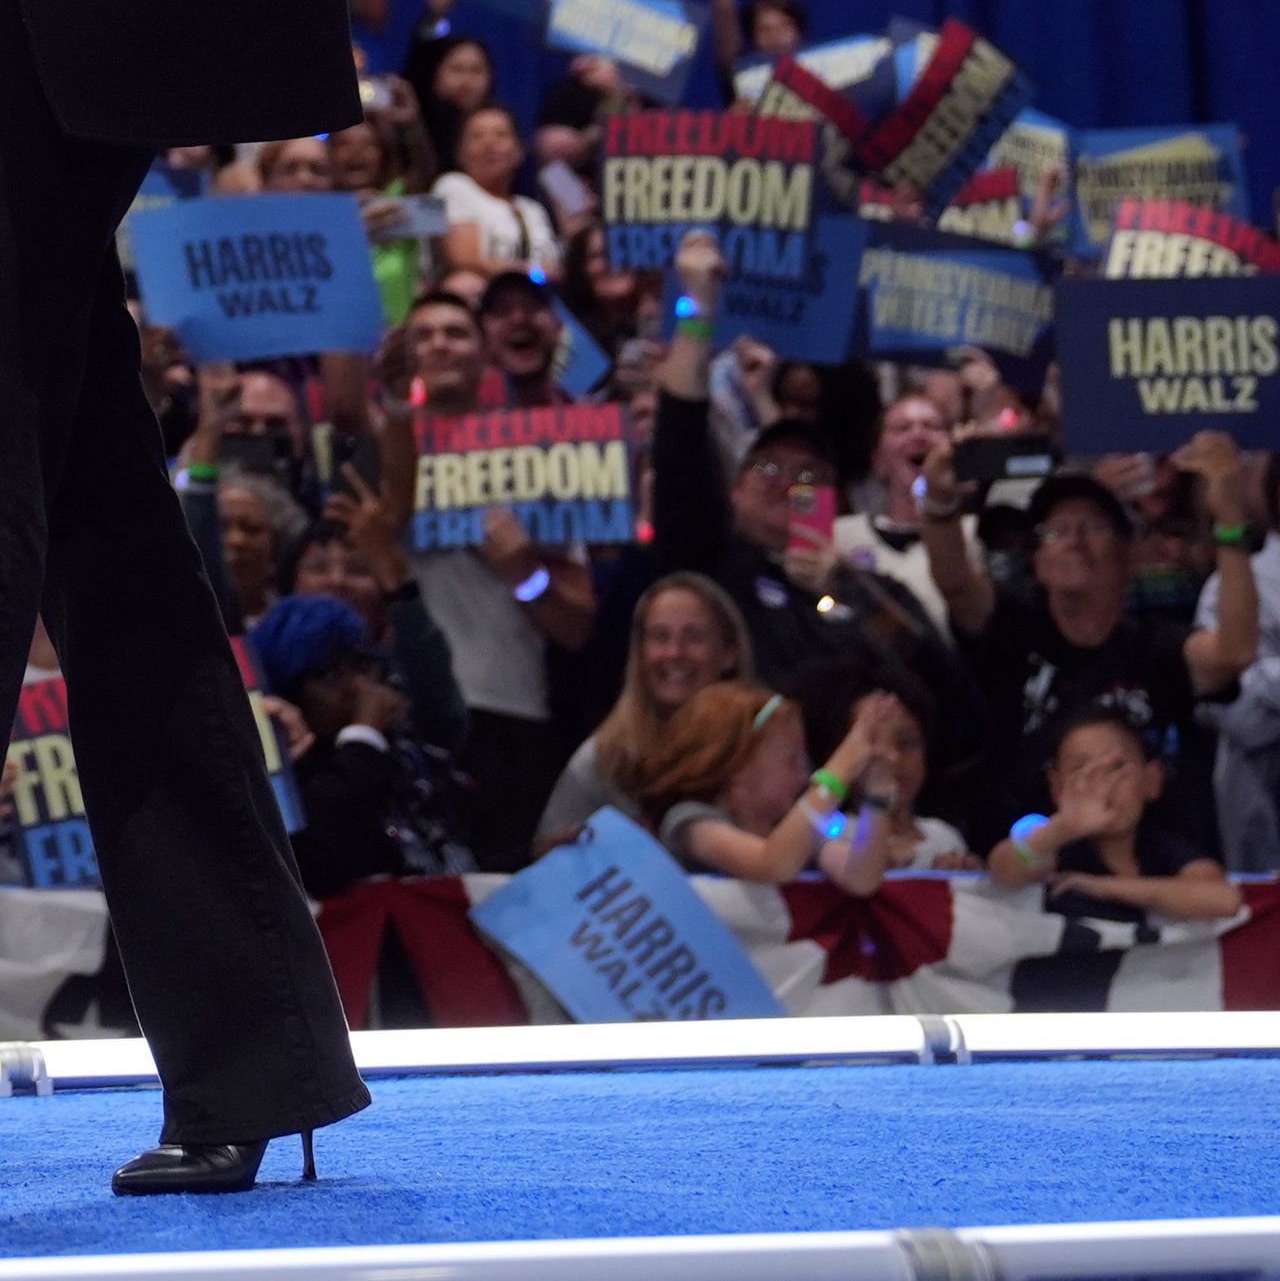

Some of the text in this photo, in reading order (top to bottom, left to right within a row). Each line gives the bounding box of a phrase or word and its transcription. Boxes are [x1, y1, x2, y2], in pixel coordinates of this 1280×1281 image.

[604, 155, 814, 232] FREEDOM
[183, 230, 334, 289] HARRIS
[217, 284, 318, 320] WALZ
[1108, 315, 1280, 379] HARRIS
[1138, 377, 1259, 415] WALZ
[414, 439, 630, 511] FREEDOM
[574, 864, 727, 1021] HARRIS
